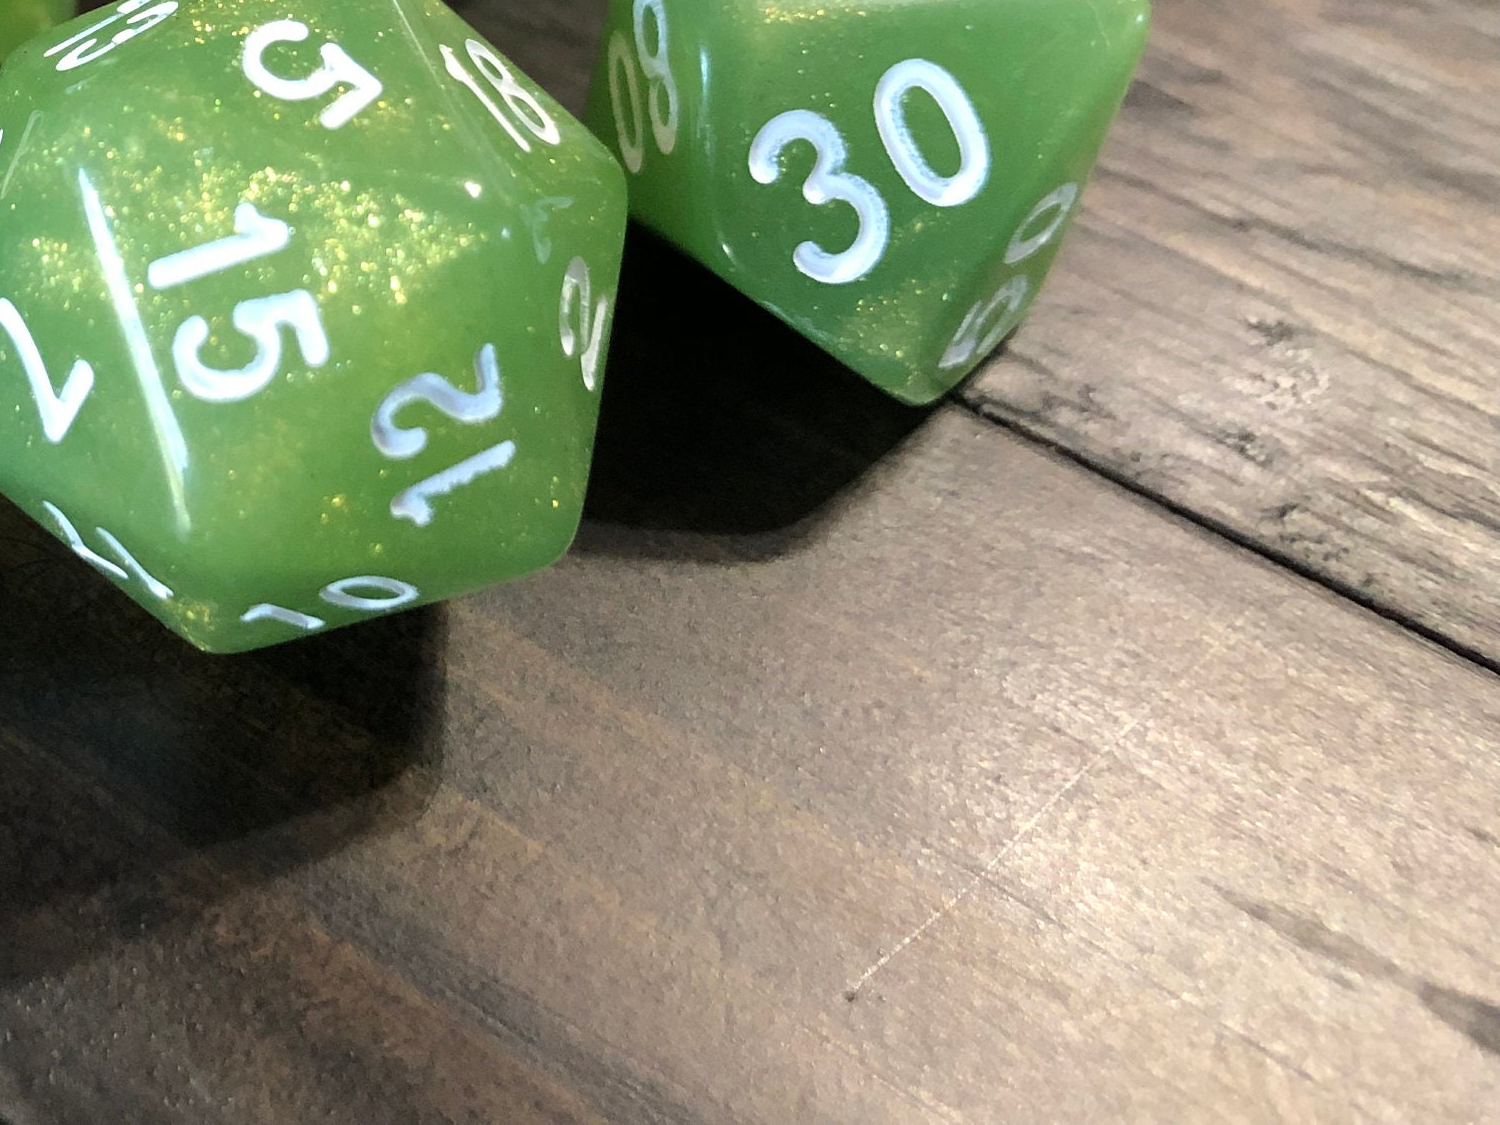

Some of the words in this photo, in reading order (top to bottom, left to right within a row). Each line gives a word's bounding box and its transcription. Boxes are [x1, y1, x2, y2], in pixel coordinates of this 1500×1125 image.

[242, 20, 384, 130] 5
[439, 38, 560, 153] 18
[747, 58, 991, 285] 30
[148, 202, 330, 402] 15
[371, 344, 517, 527] 12
[240, 575, 419, 629] 10
